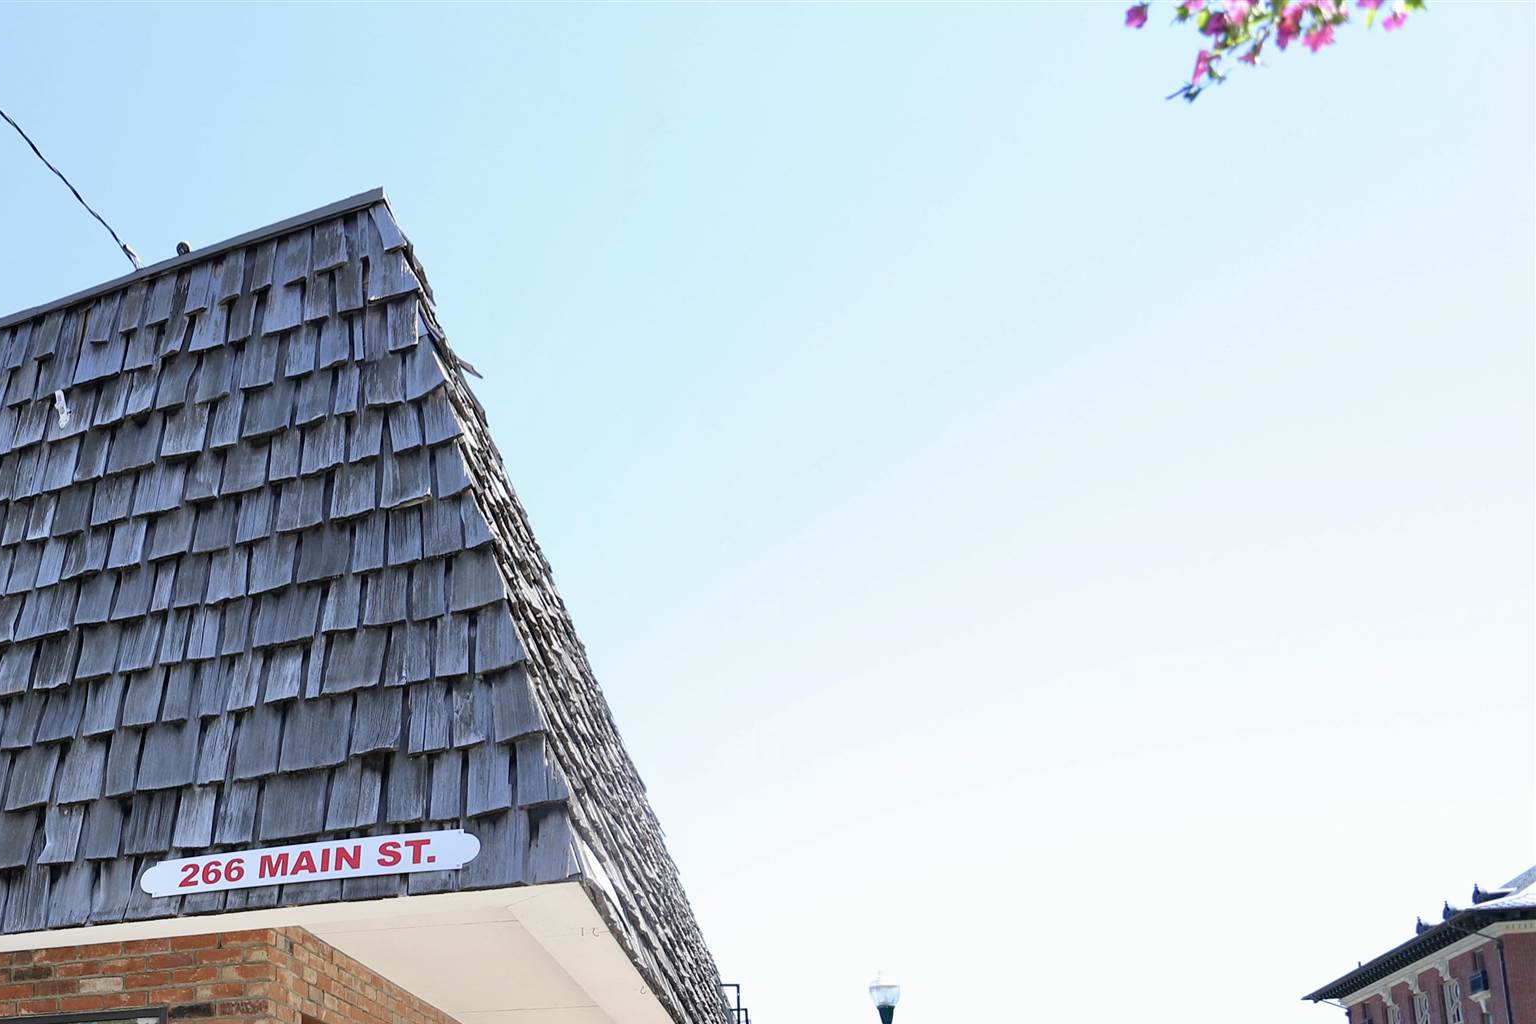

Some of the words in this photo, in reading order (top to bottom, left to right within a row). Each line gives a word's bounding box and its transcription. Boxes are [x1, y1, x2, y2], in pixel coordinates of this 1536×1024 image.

[179, 858, 245, 888] 266
[258, 845, 362, 879] MAIN
[377, 839, 437, 867] ST.
